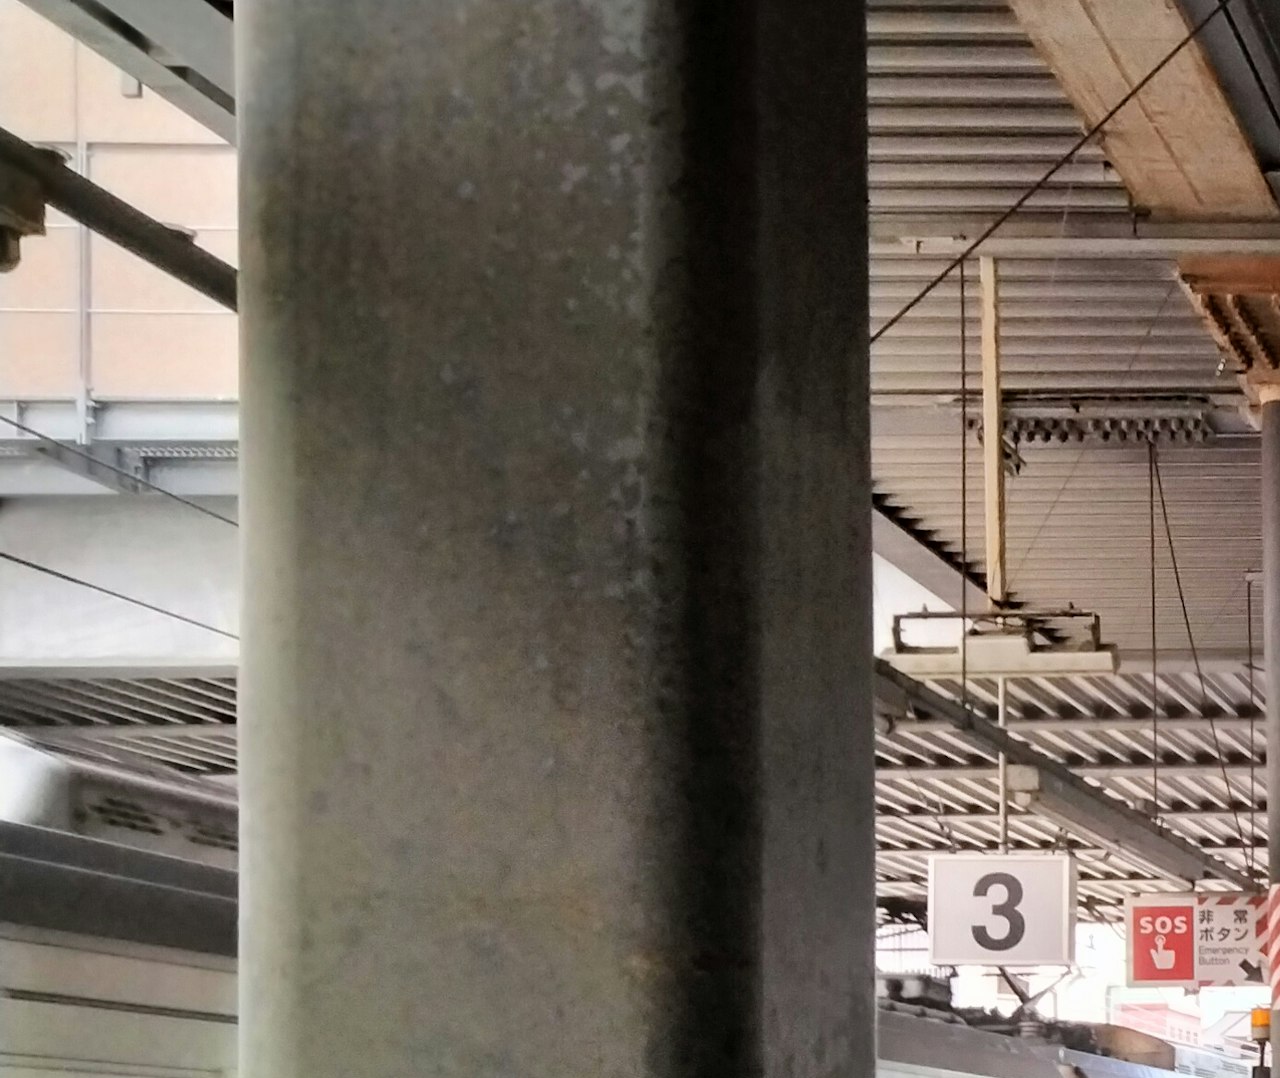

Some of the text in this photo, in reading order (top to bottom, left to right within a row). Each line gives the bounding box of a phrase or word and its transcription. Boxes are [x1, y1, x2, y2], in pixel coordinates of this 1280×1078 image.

[971, 871, 1025, 951] 3
[1198, 909, 1249, 925] 非常
[1139, 915, 1188, 935] SOS
[1199, 926, 1249, 942] ボタン
[1198, 945, 1249, 956] Emergency
[1198, 957, 1231, 966] Button
